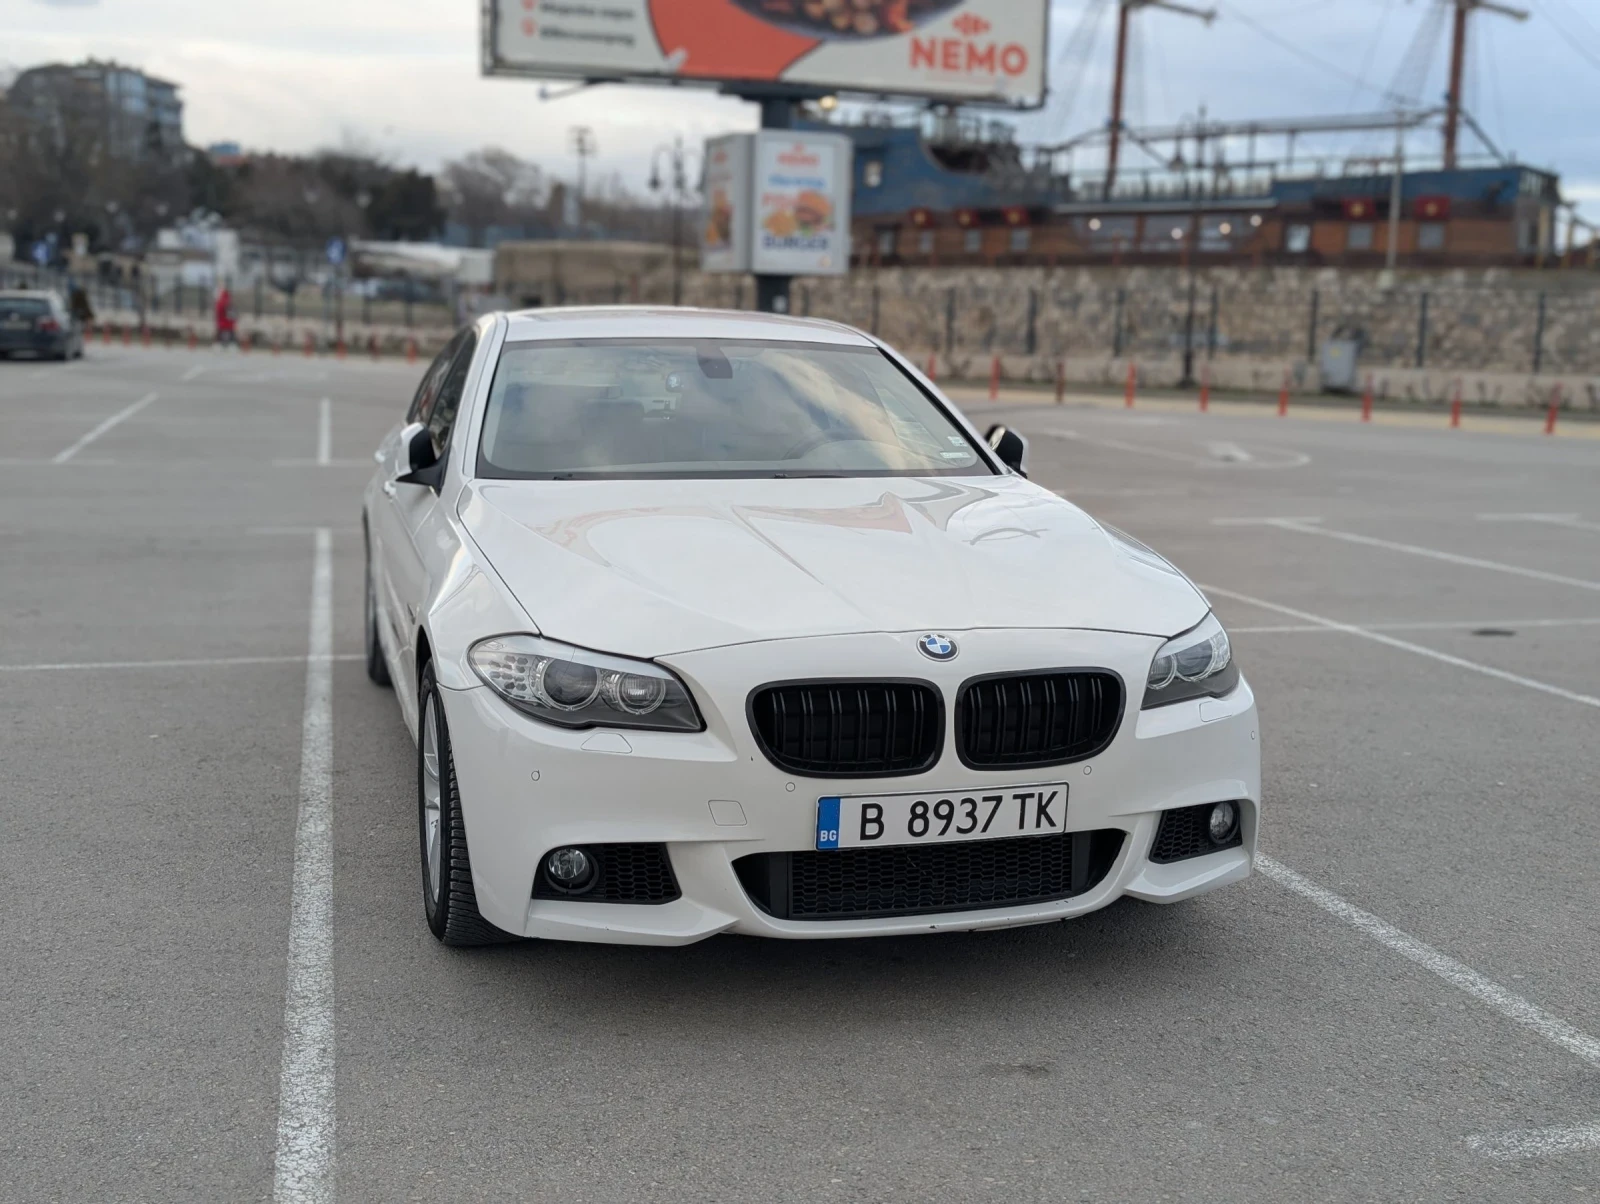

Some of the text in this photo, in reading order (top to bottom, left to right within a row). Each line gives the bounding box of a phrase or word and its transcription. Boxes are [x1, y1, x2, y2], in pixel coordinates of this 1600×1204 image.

[909, 37, 1028, 77] NEMO
[820, 791, 1059, 842] BG B 8937 TK
